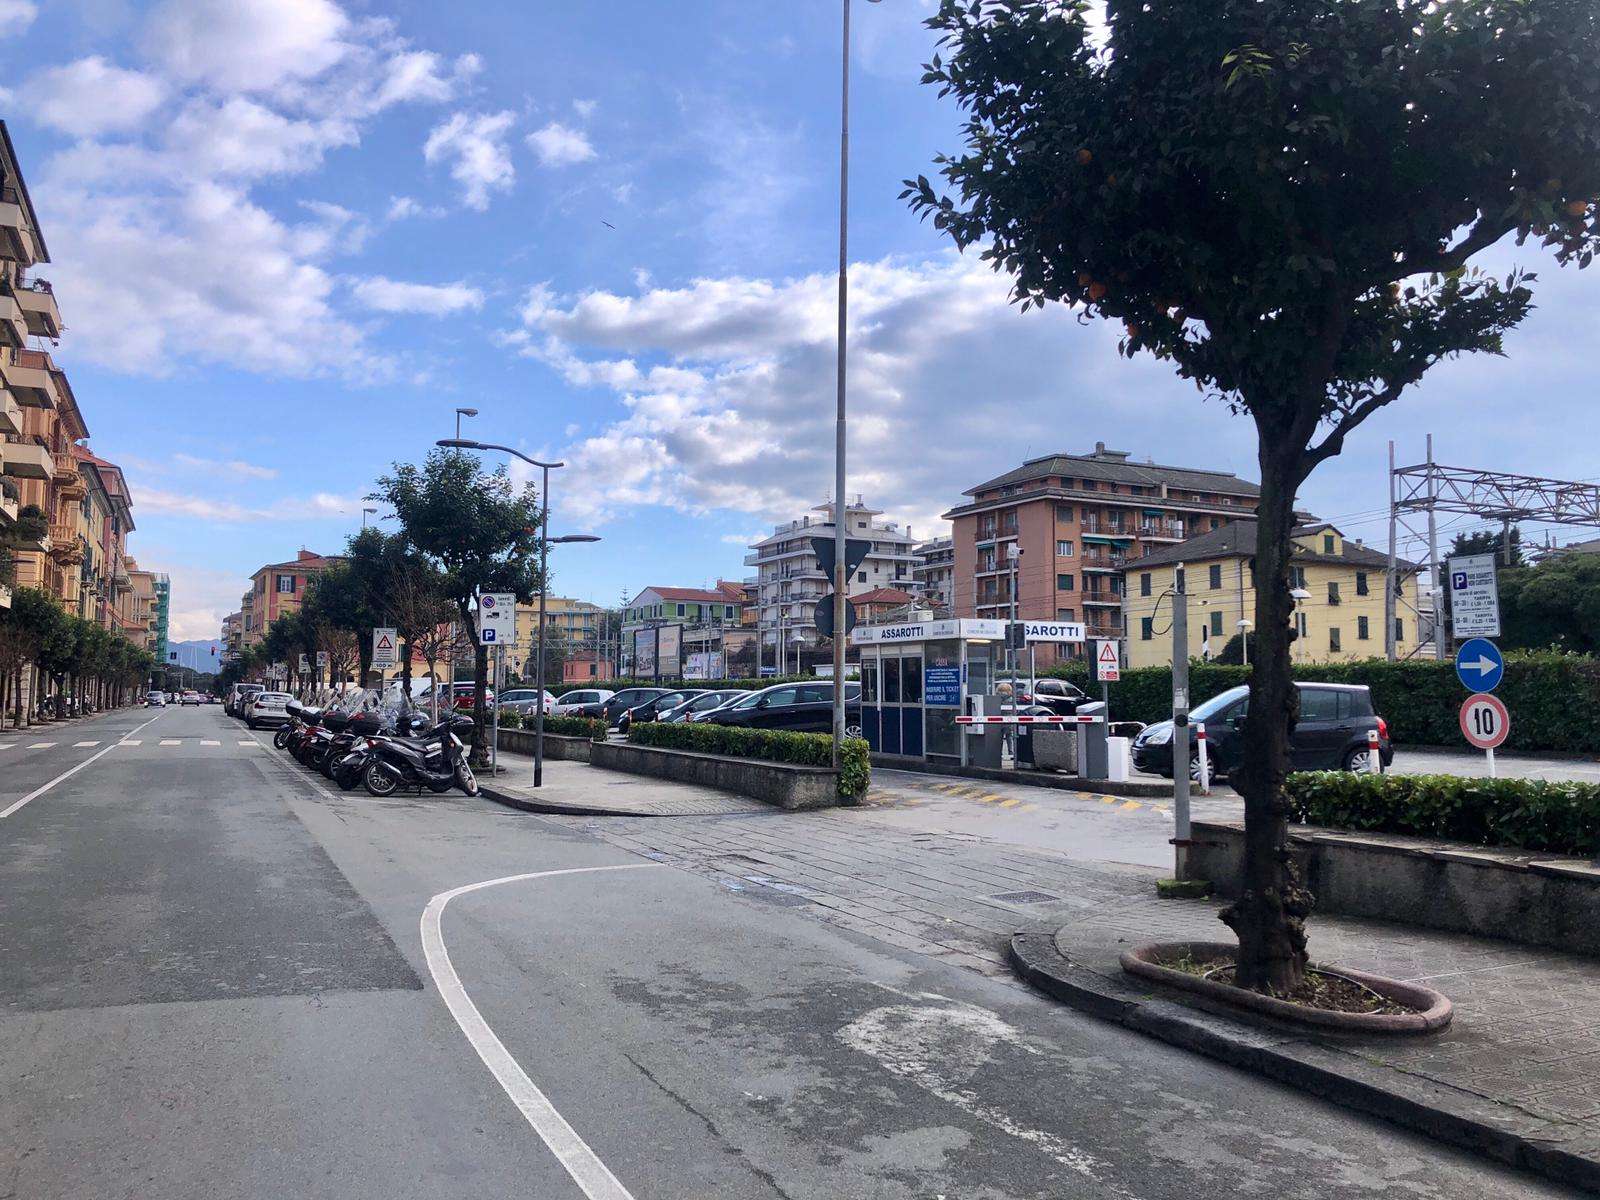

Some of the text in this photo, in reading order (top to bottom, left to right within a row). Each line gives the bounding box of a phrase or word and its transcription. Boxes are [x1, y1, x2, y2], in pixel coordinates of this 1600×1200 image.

[881, 626, 923, 638] ASSAROTTI
[1026, 625, 1078, 637] SAROTTI
[1475, 708, 1494, 735] 10
